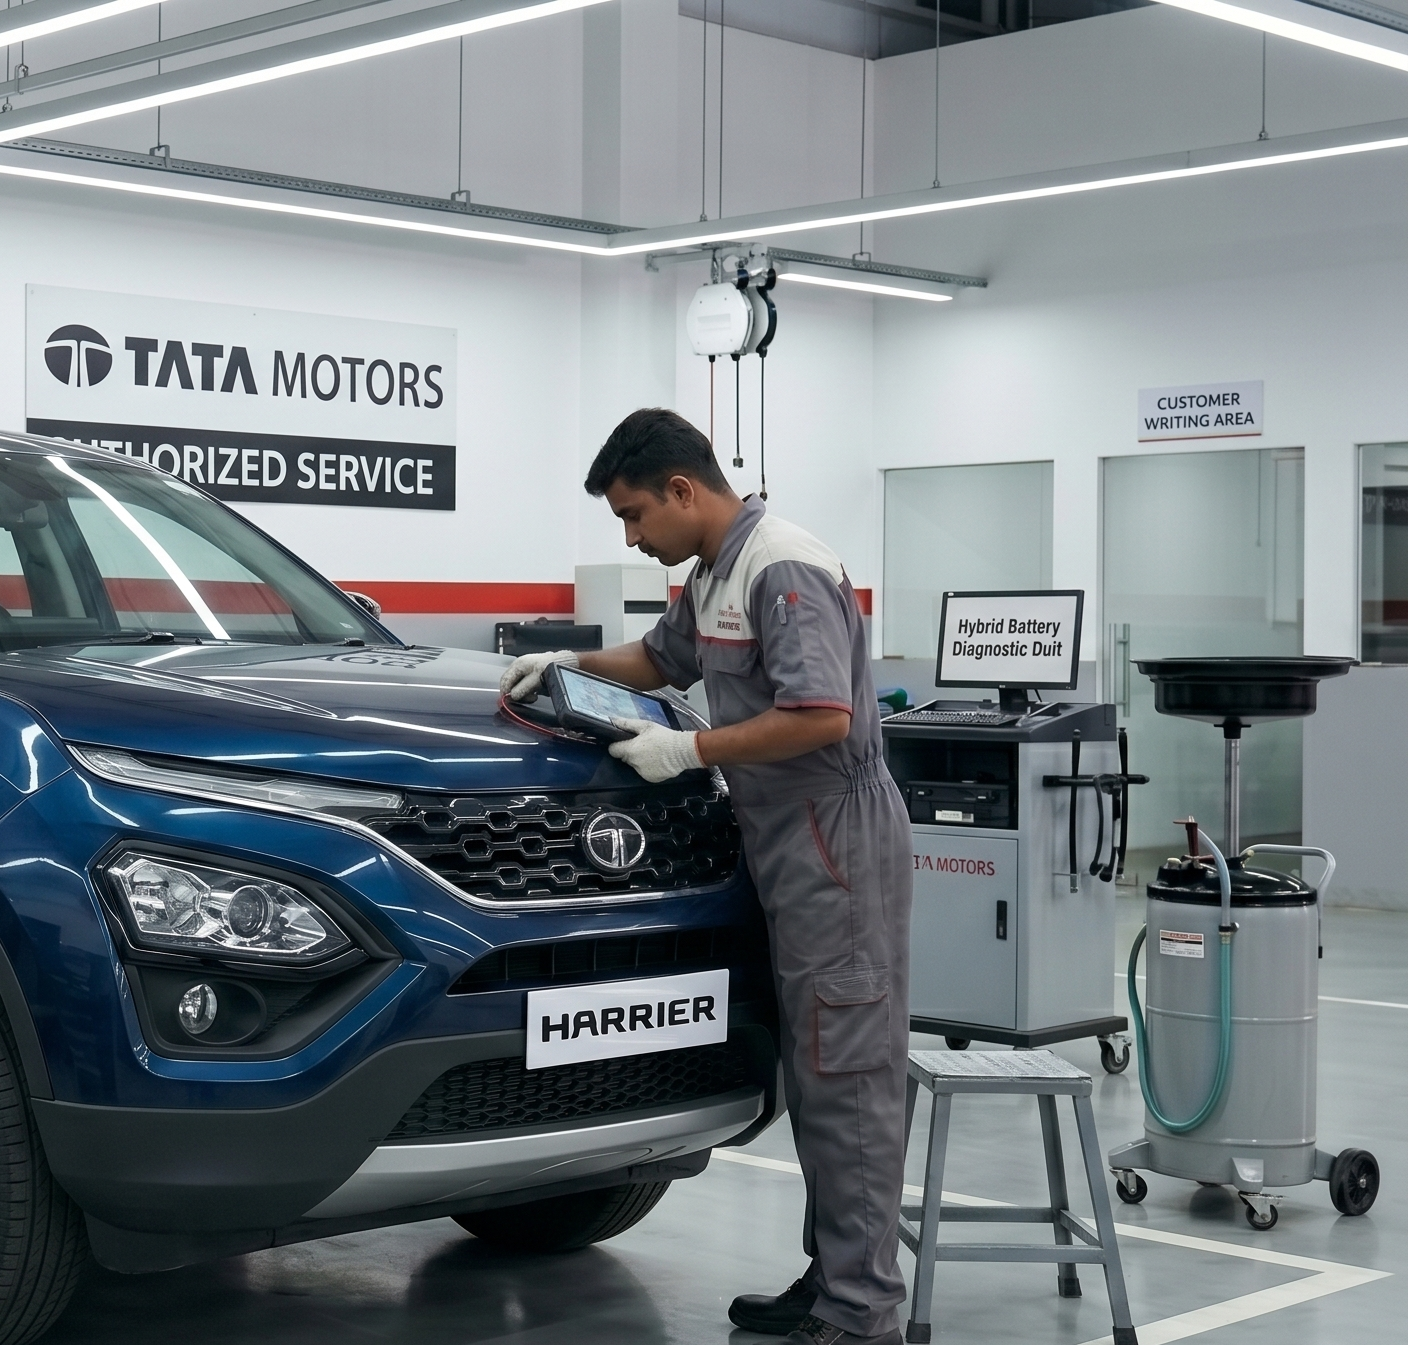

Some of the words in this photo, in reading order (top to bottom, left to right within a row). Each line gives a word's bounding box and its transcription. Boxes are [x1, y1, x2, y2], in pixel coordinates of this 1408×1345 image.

[125, 336, 258, 395] TATA
[272, 350, 444, 409] MOTORS
[1157, 392, 1240, 410] CUSTOMER
[1144, 414, 1209, 430] WRITING
[1214, 412, 1254, 426] AREA
[296, 452, 434, 495] SERVICE
[958, 618, 1004, 638] Hybrid
[1008, 618, 1061, 638] Battery
[952, 641, 1028, 660] Diagnostic
[1032, 641, 1063, 657] Duit
[936, 857, 995, 876] MOTORS
[542, 995, 717, 1043] HARRIER
